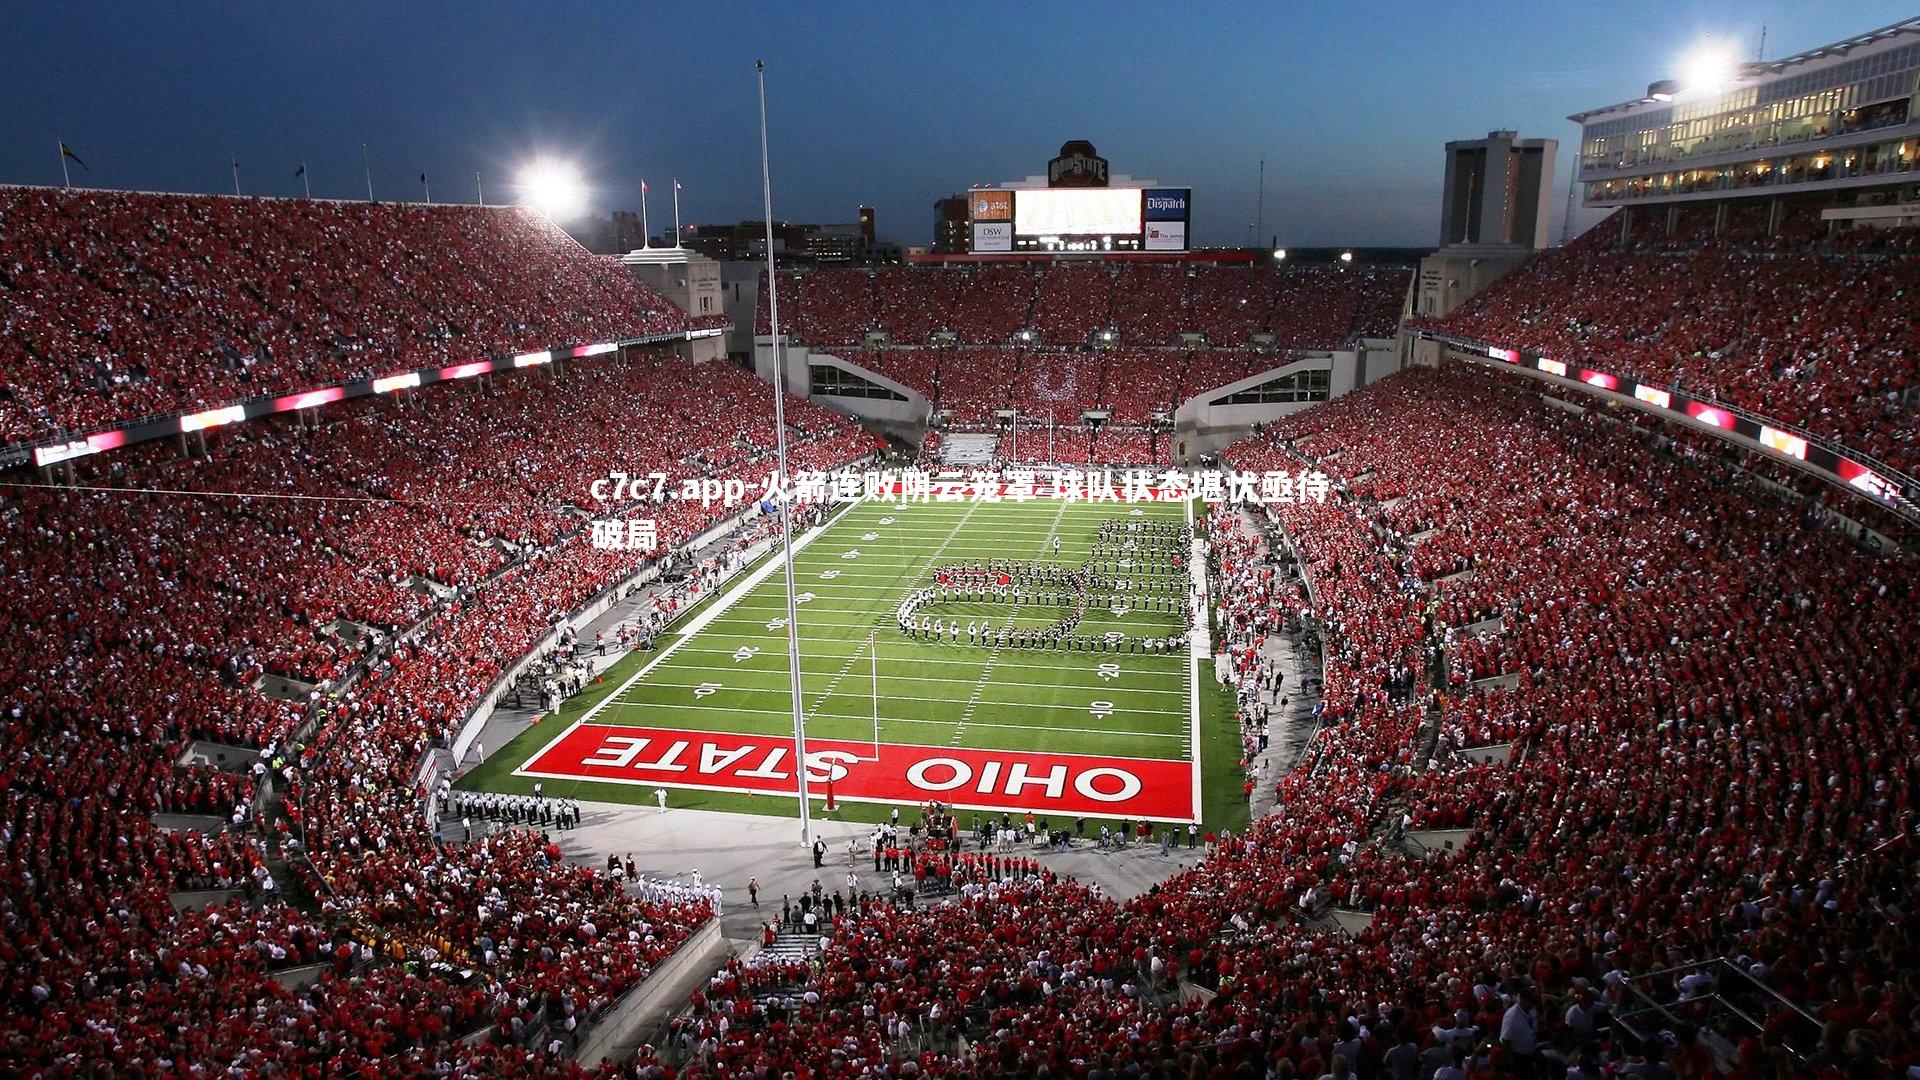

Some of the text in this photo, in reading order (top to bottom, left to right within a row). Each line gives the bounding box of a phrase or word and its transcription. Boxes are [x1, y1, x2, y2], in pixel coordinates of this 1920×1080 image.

[1147, 197, 1185, 211] Dispatch
[983, 228, 1003, 237] DSW
[1097, 663, 1120, 677] 20
[693, 682, 723, 696] 10
[1089, 701, 1114, 715] 10
[580, 735, 1142, 802] OHIO STATE
